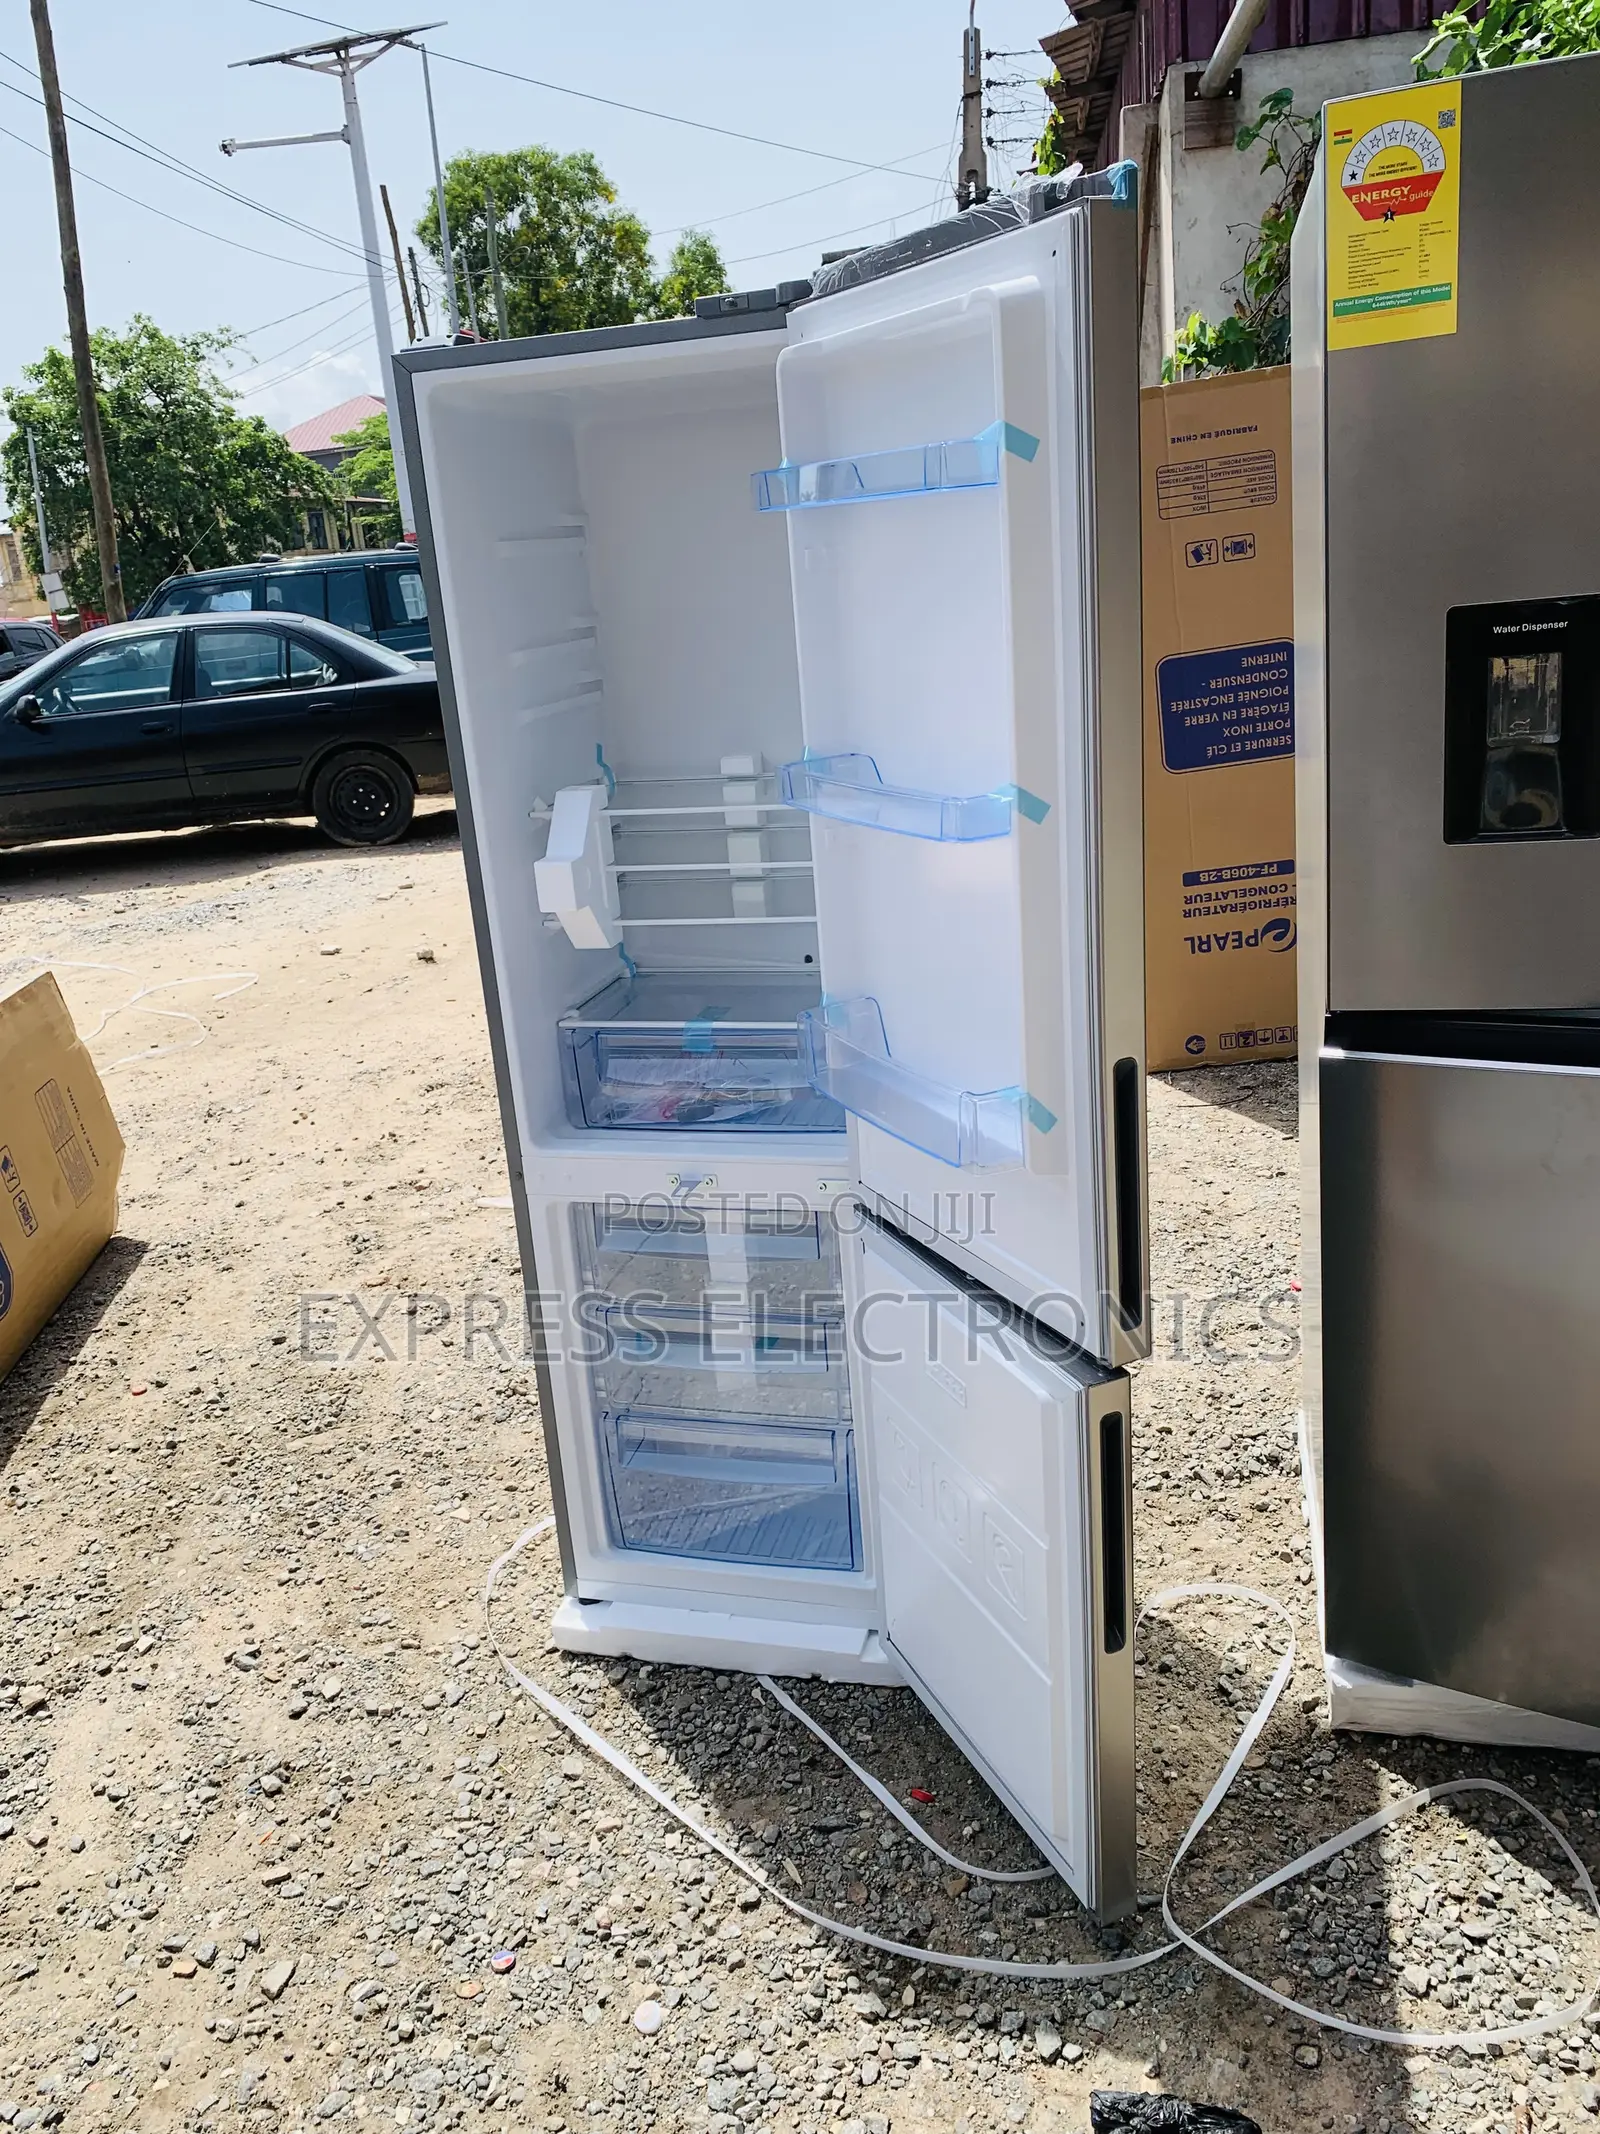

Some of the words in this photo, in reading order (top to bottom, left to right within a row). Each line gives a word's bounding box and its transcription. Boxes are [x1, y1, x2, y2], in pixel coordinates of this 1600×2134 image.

[1351, 185, 1411, 204] ENERGY
[1409, 190, 1433, 201] guide
[1375, 291, 1412, 301] Consumption
[1432, 285, 1451, 293] Model
[1171, 434, 1197, 444] CHINE
[1200, 431, 1211, 439] EN
[1210, 469, 1242, 478] EMBALLAGE
[1493, 624, 1520, 634] Water
[1522, 620, 1568, 632] Dispenser
[1241, 651, 1287, 667] INTERNE
[1210, 668, 1288, 689] CONDENSUER
[1238, 685, 1288, 702] POIGNÉE
[1170, 694, 1234, 713] ENCASTRÉE
[1241, 702, 1289, 718] ÉTAGÈRE
[1184, 713, 1219, 726] VERRE
[1223, 710, 1236, 720] EN
[1223, 724, 1252, 737] INOX
[1256, 719, 1290, 733] PORTE
[1230, 742, 1241, 752] ET
[1245, 735, 1292, 750] SERRURE
[1206, 745, 1227, 758] CLÉ
[1199, 863, 1278, 882] PF-406B-2B
[1184, 883, 1287, 905] CONGELATEUR
[1182, 896, 1295, 918] RÉFRIGÉRATEUR
[1184, 928, 1260, 954] PEARL
